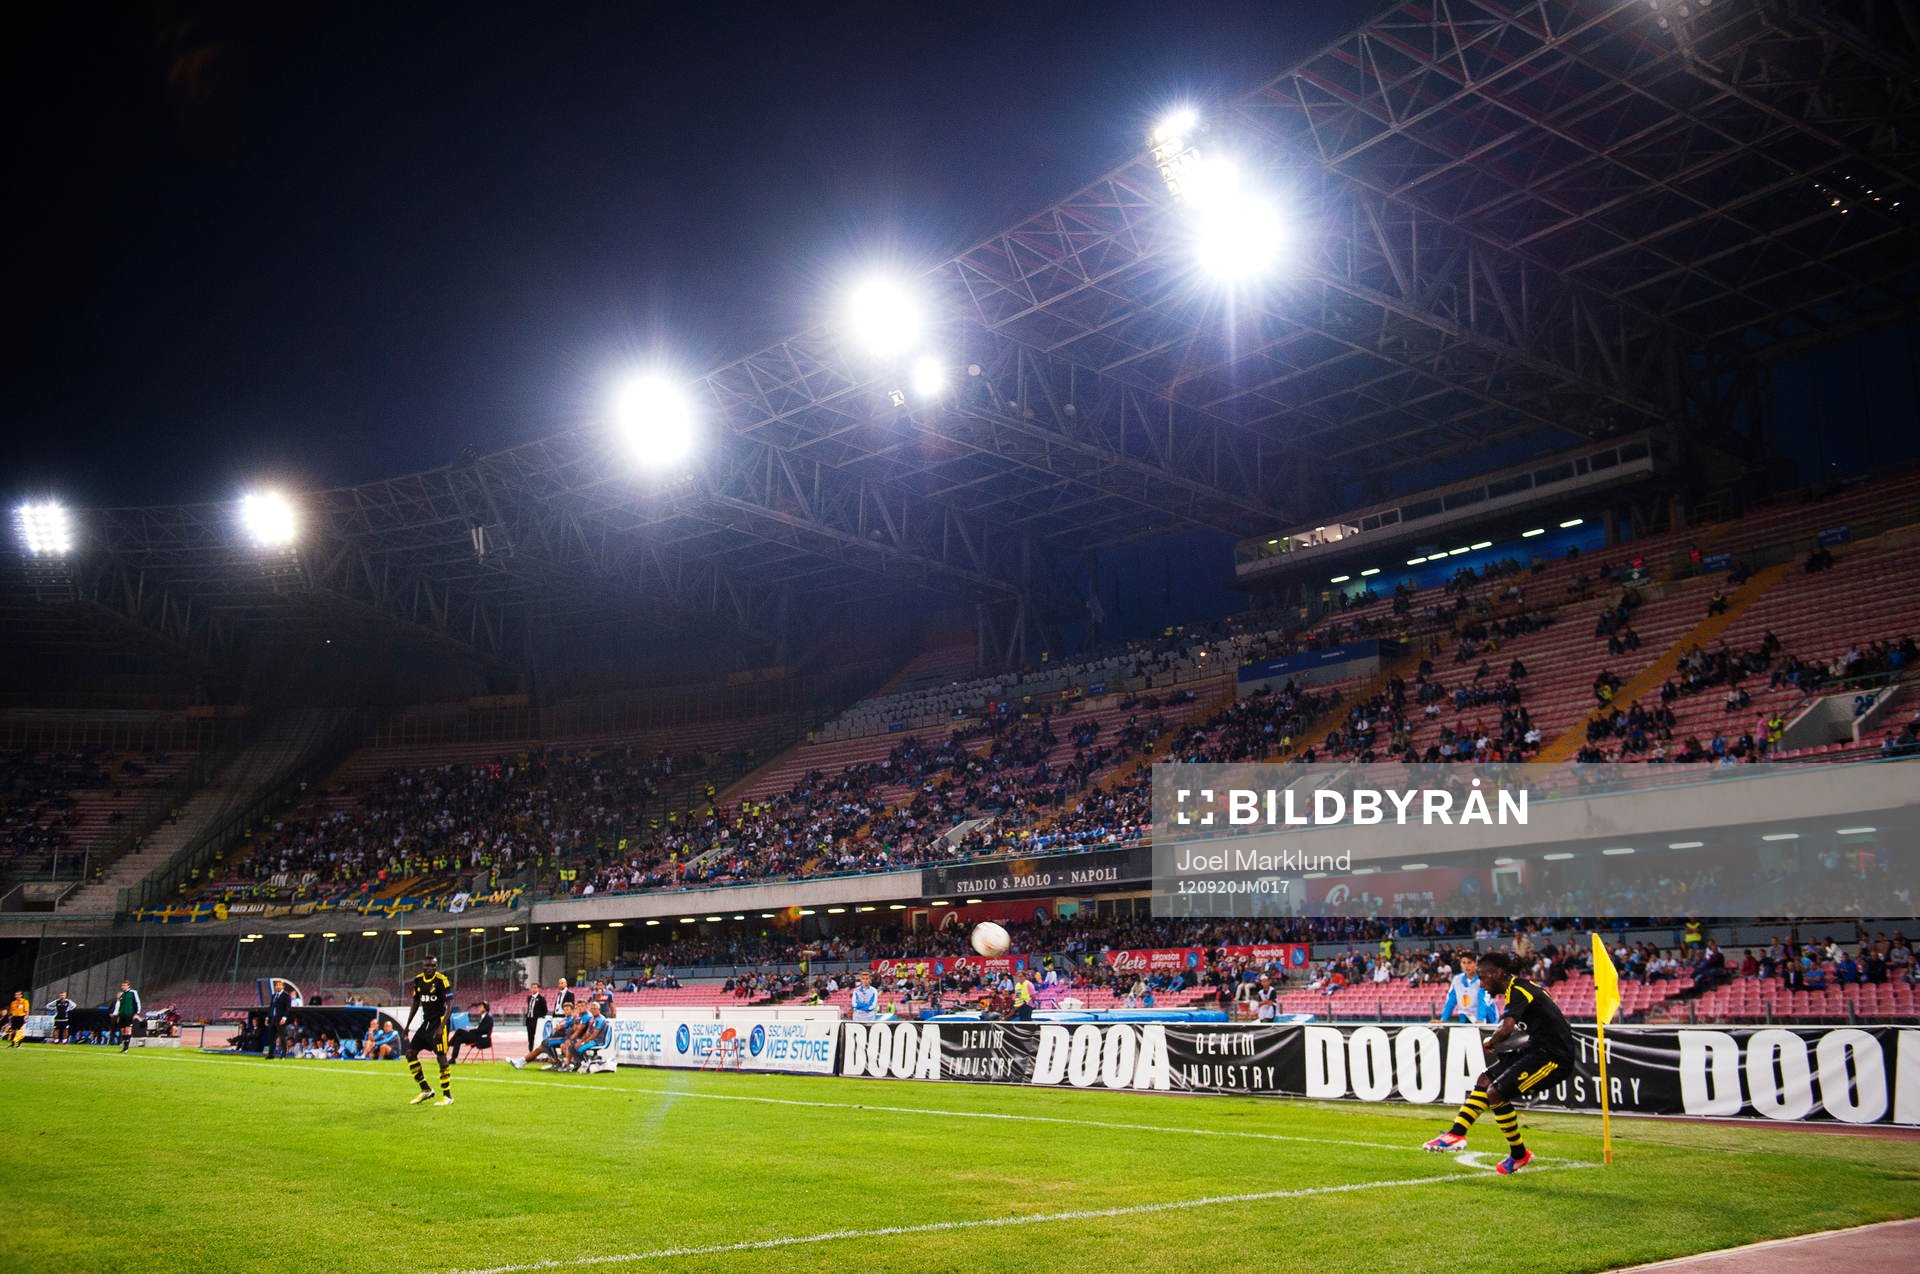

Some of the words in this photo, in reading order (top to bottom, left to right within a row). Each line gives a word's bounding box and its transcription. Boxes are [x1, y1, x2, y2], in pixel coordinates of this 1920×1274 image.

[957, 879, 996, 892] STADIO
[1014, 873, 1051, 888] PAOLO
[1071, 867, 1118, 883] NAPOLI
[1112, 951, 1147, 972] Lete
[1151, 953, 1180, 961] SPONSOR
[877, 959, 900, 978] Let
[692, 1023, 704, 1036] SSC
[767, 1025, 781, 1037] SSC
[782, 1024, 808, 1038] NAPOLI
[962, 1029, 1005, 1049] DENIM
[633, 1034, 661, 1052] STORE
[692, 1037, 713, 1057] WEB
[766, 1039, 789, 1059] WEB
[790, 1040, 830, 1061] STORE
[843, 1022, 941, 1079] DOOA
[1196, 1033, 1255, 1056] DENIM
[949, 1057, 1014, 1077] INDUSTRY
[1032, 1024, 1171, 1090] DOOA
[1304, 1025, 1487, 1105] DOOA
[1182, 1063, 1276, 1089] INDUSTRY
[1521, 1075, 1641, 1105] USTRY
